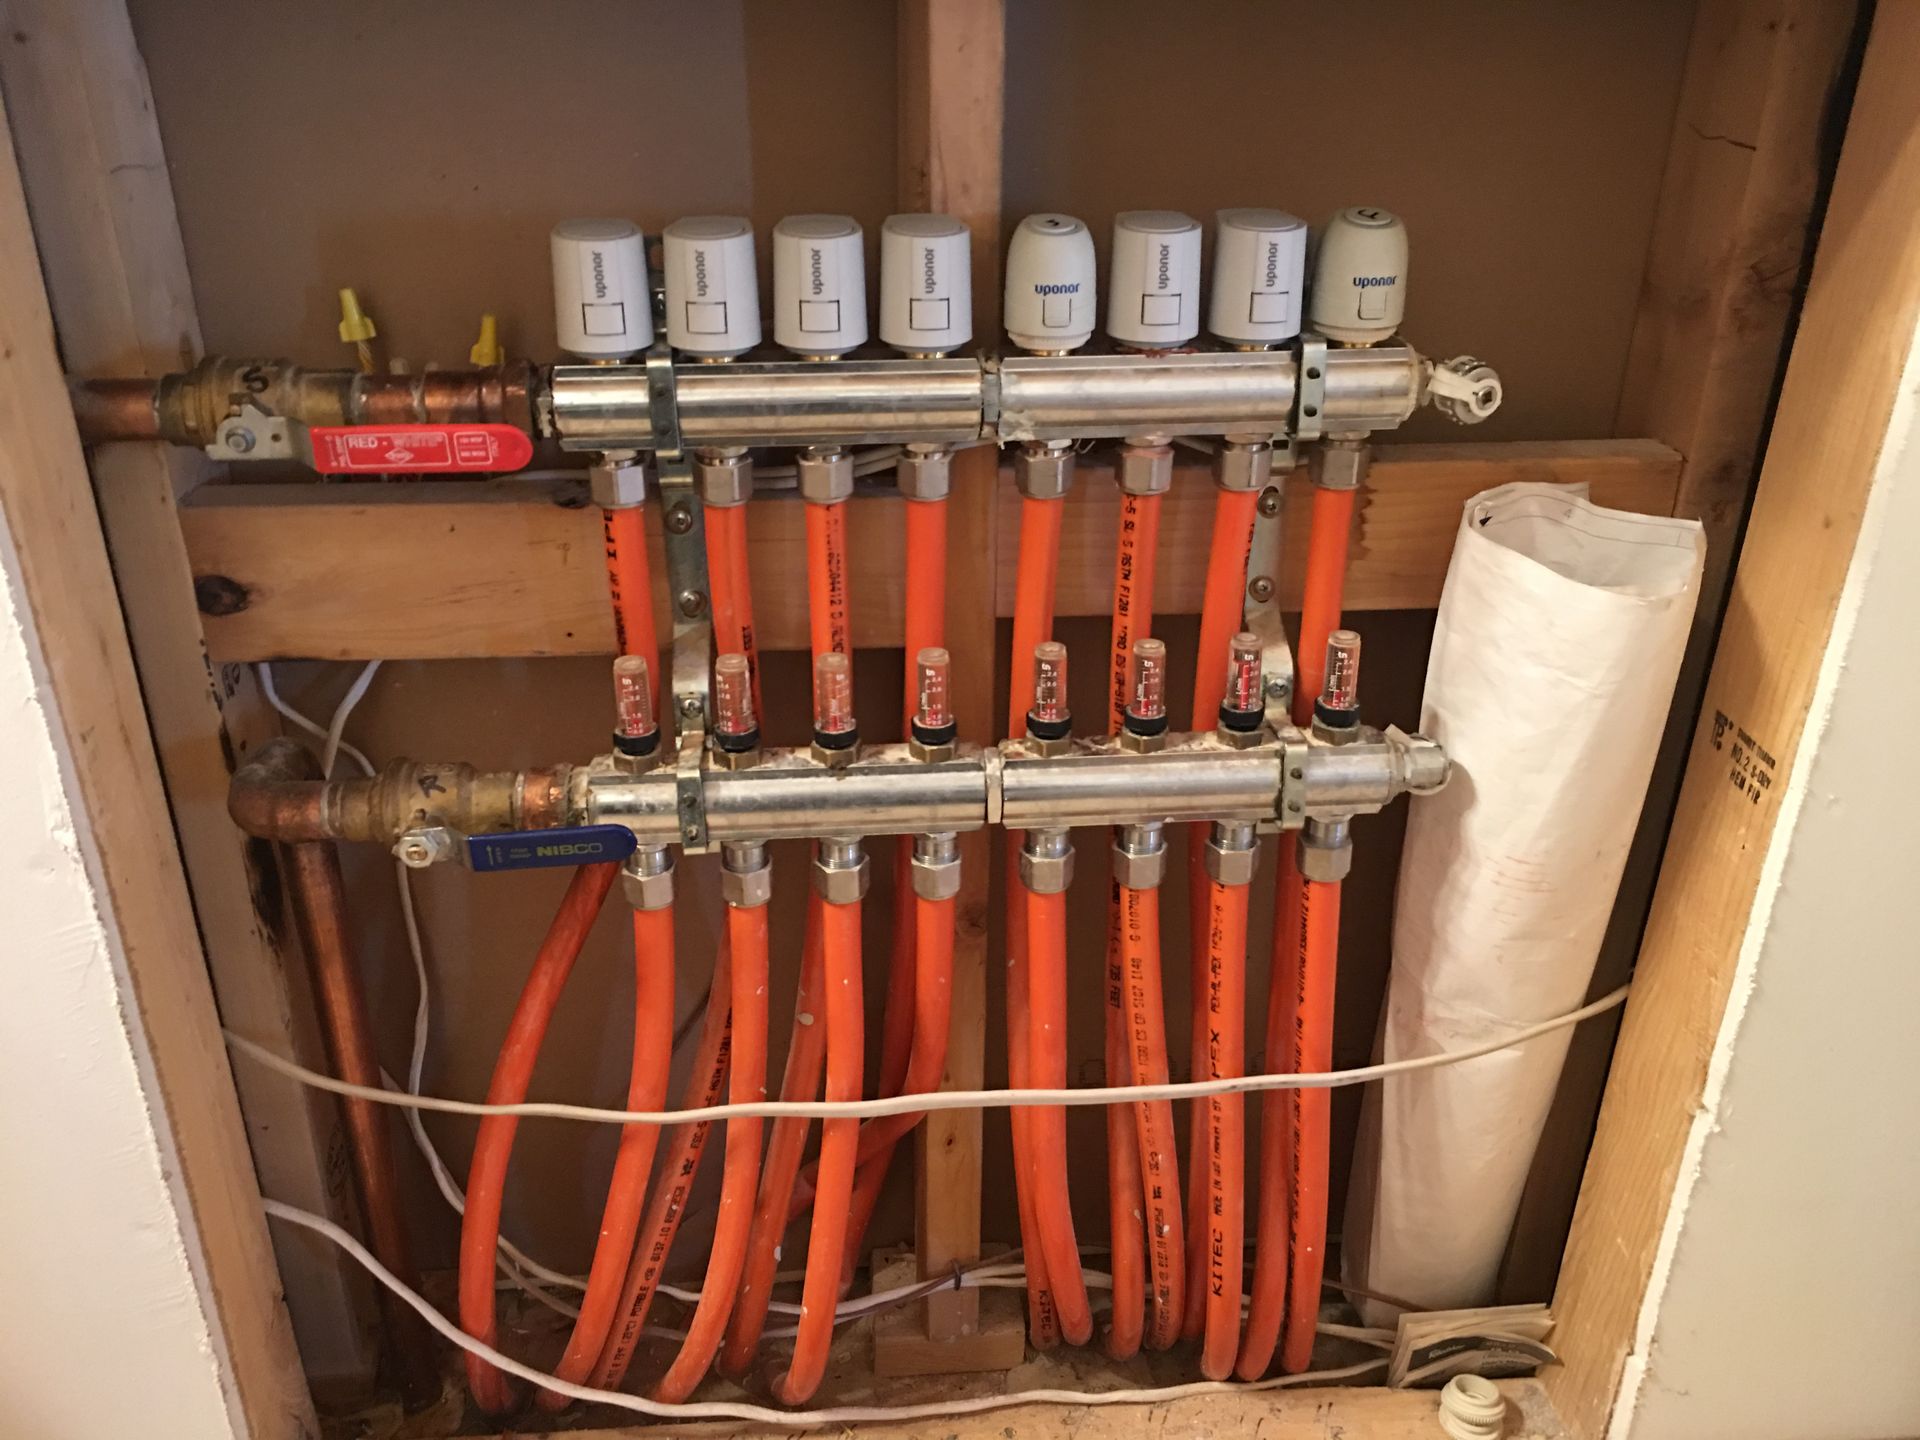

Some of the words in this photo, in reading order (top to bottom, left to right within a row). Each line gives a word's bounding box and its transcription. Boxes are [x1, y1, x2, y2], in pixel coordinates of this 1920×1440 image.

[592, 250, 608, 298] uponor
[695, 249, 708, 297] uponor
[811, 249, 825, 295] uponor
[924, 248, 937, 294] uponor
[1158, 243, 1171, 290] uponor
[1266, 241, 1279, 287] uponor
[1353, 275, 1397, 289] uponor
[1034, 283, 1080, 297] uponor
[349, 435, 378, 448] RED
[1729, 768, 1747, 790] HEM
[1746, 783, 1761, 805] FIR
[536, 842, 603, 858] NIBCO
[1211, 1228, 1223, 1298] KITEC
